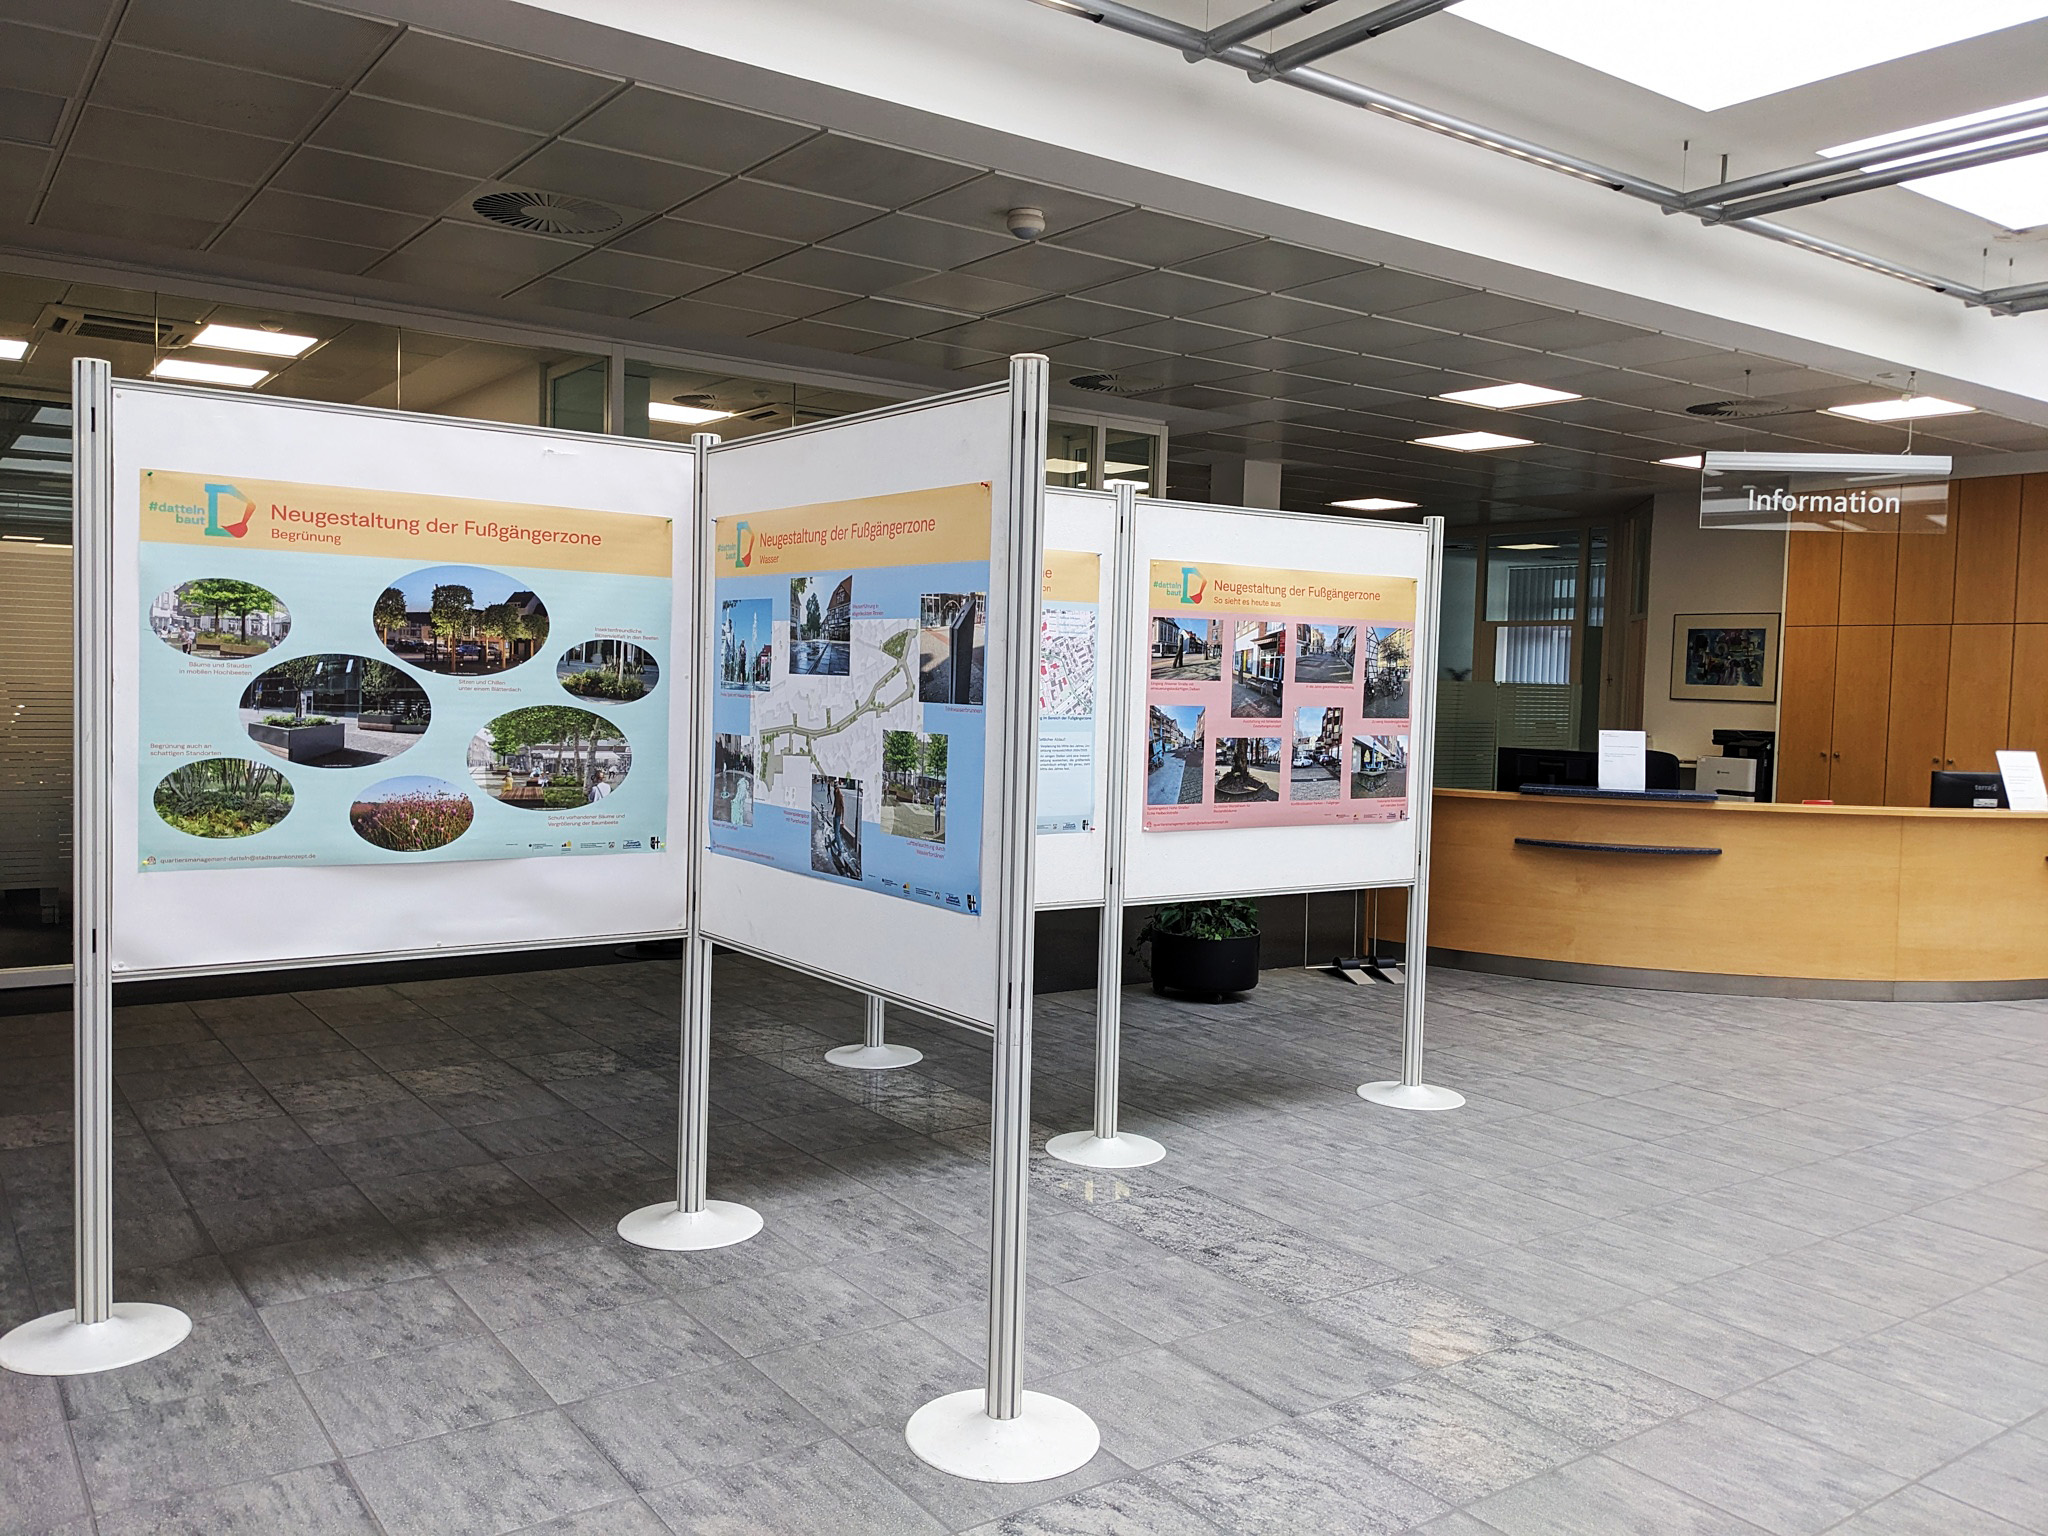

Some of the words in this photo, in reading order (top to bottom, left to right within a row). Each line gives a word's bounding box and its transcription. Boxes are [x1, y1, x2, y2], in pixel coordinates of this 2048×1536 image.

[149, 501, 205, 515] #datteln
[1748, 488, 1900, 514] Information
[175, 513, 205, 525] baut
[271, 503, 421, 536] Neugestaltung
[426, 517, 459, 534] der
[464, 520, 602, 546] Fußgängerzone
[271, 528, 342, 546] Begrünung
[759, 527, 828, 550] Neugestaltung
[830, 524, 849, 541] der
[850, 517, 936, 542] Fußgängerzone
[759, 554, 780, 565] Wasser
[1153, 580, 1182, 590] #datteln
[1166, 588, 1182, 596] baut
[1213, 579, 1287, 598] Neugestaltung
[1289, 586, 1306, 598] der
[1308, 586, 1381, 602] Fußgängerzone
[1213, 596, 1223, 604] So
[1224, 597, 1241, 606] sieht
[1251, 599, 1269, 607] heute
